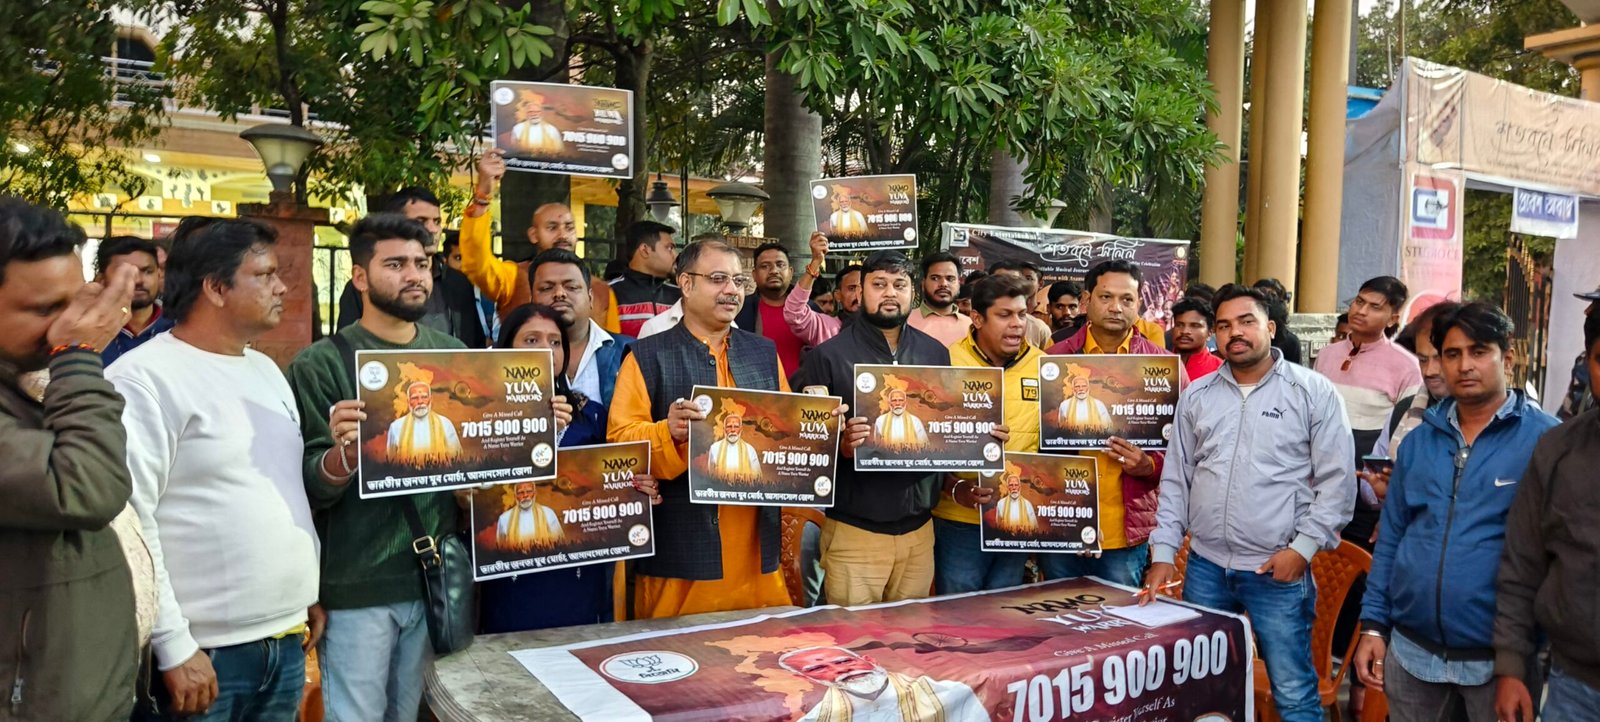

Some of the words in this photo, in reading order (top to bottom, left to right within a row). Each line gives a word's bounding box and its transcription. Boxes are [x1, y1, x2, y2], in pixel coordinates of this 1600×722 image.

[888, 192, 909, 200] YUVA
[972, 229, 987, 237] City
[504, 366, 540, 379] NAMO
[1143, 367, 1171, 376] NAMO
[504, 380, 542, 395] YUVA
[963, 380, 993, 391] NAMO
[1143, 376, 1170, 388] YUVA
[506, 393, 542, 402] WARRIORS
[962, 391, 993, 403] YUVA
[1025, 388, 1037, 398] 79
[801, 409, 830, 421] NAMO
[1111, 404, 1134, 415] 7015
[1136, 404, 1154, 415] 900
[1156, 404, 1173, 415] 900
[462, 421, 492, 438] 7015
[494, 419, 520, 435] 900
[523, 417, 547, 434] 900
[800, 421, 829, 436] YUVA
[928, 421, 952, 433] 7015
[954, 421, 974, 433] 900
[799, 432, 829, 440] WARRIORS
[602, 457, 638, 469] NAMO
[762, 451, 785, 465] 7015
[788, 452, 808, 465] 900
[809, 453, 829, 467] 900
[367, 476, 402, 490] ভারতীয়
[402, 475, 428, 488] জনতা
[429, 475, 442, 487] যুব
[443, 471, 466, 483] মোর্চা,
[467, 468, 511, 480] আসানসোল
[511, 466, 533, 476] জেলা
[602, 468, 635, 482] YUVA
[1064, 468, 1089, 479] NAMO
[603, 480, 635, 490] WARRIOR
[1064, 479, 1089, 489] YUVA
[563, 508, 591, 524] 7015
[593, 504, 616, 520] 900
[619, 501, 643, 517] 900
[1037, 505, 1056, 517] 7015
[1058, 506, 1074, 518] 900
[1075, 507, 1092, 518] 900
[1002, 594, 1106, 614] NAMO
[1007, 661, 1094, 722] 7015
[1102, 644, 1166, 705] 900
[1172, 630, 1228, 685] 900
[1163, 696, 1175, 709] As
